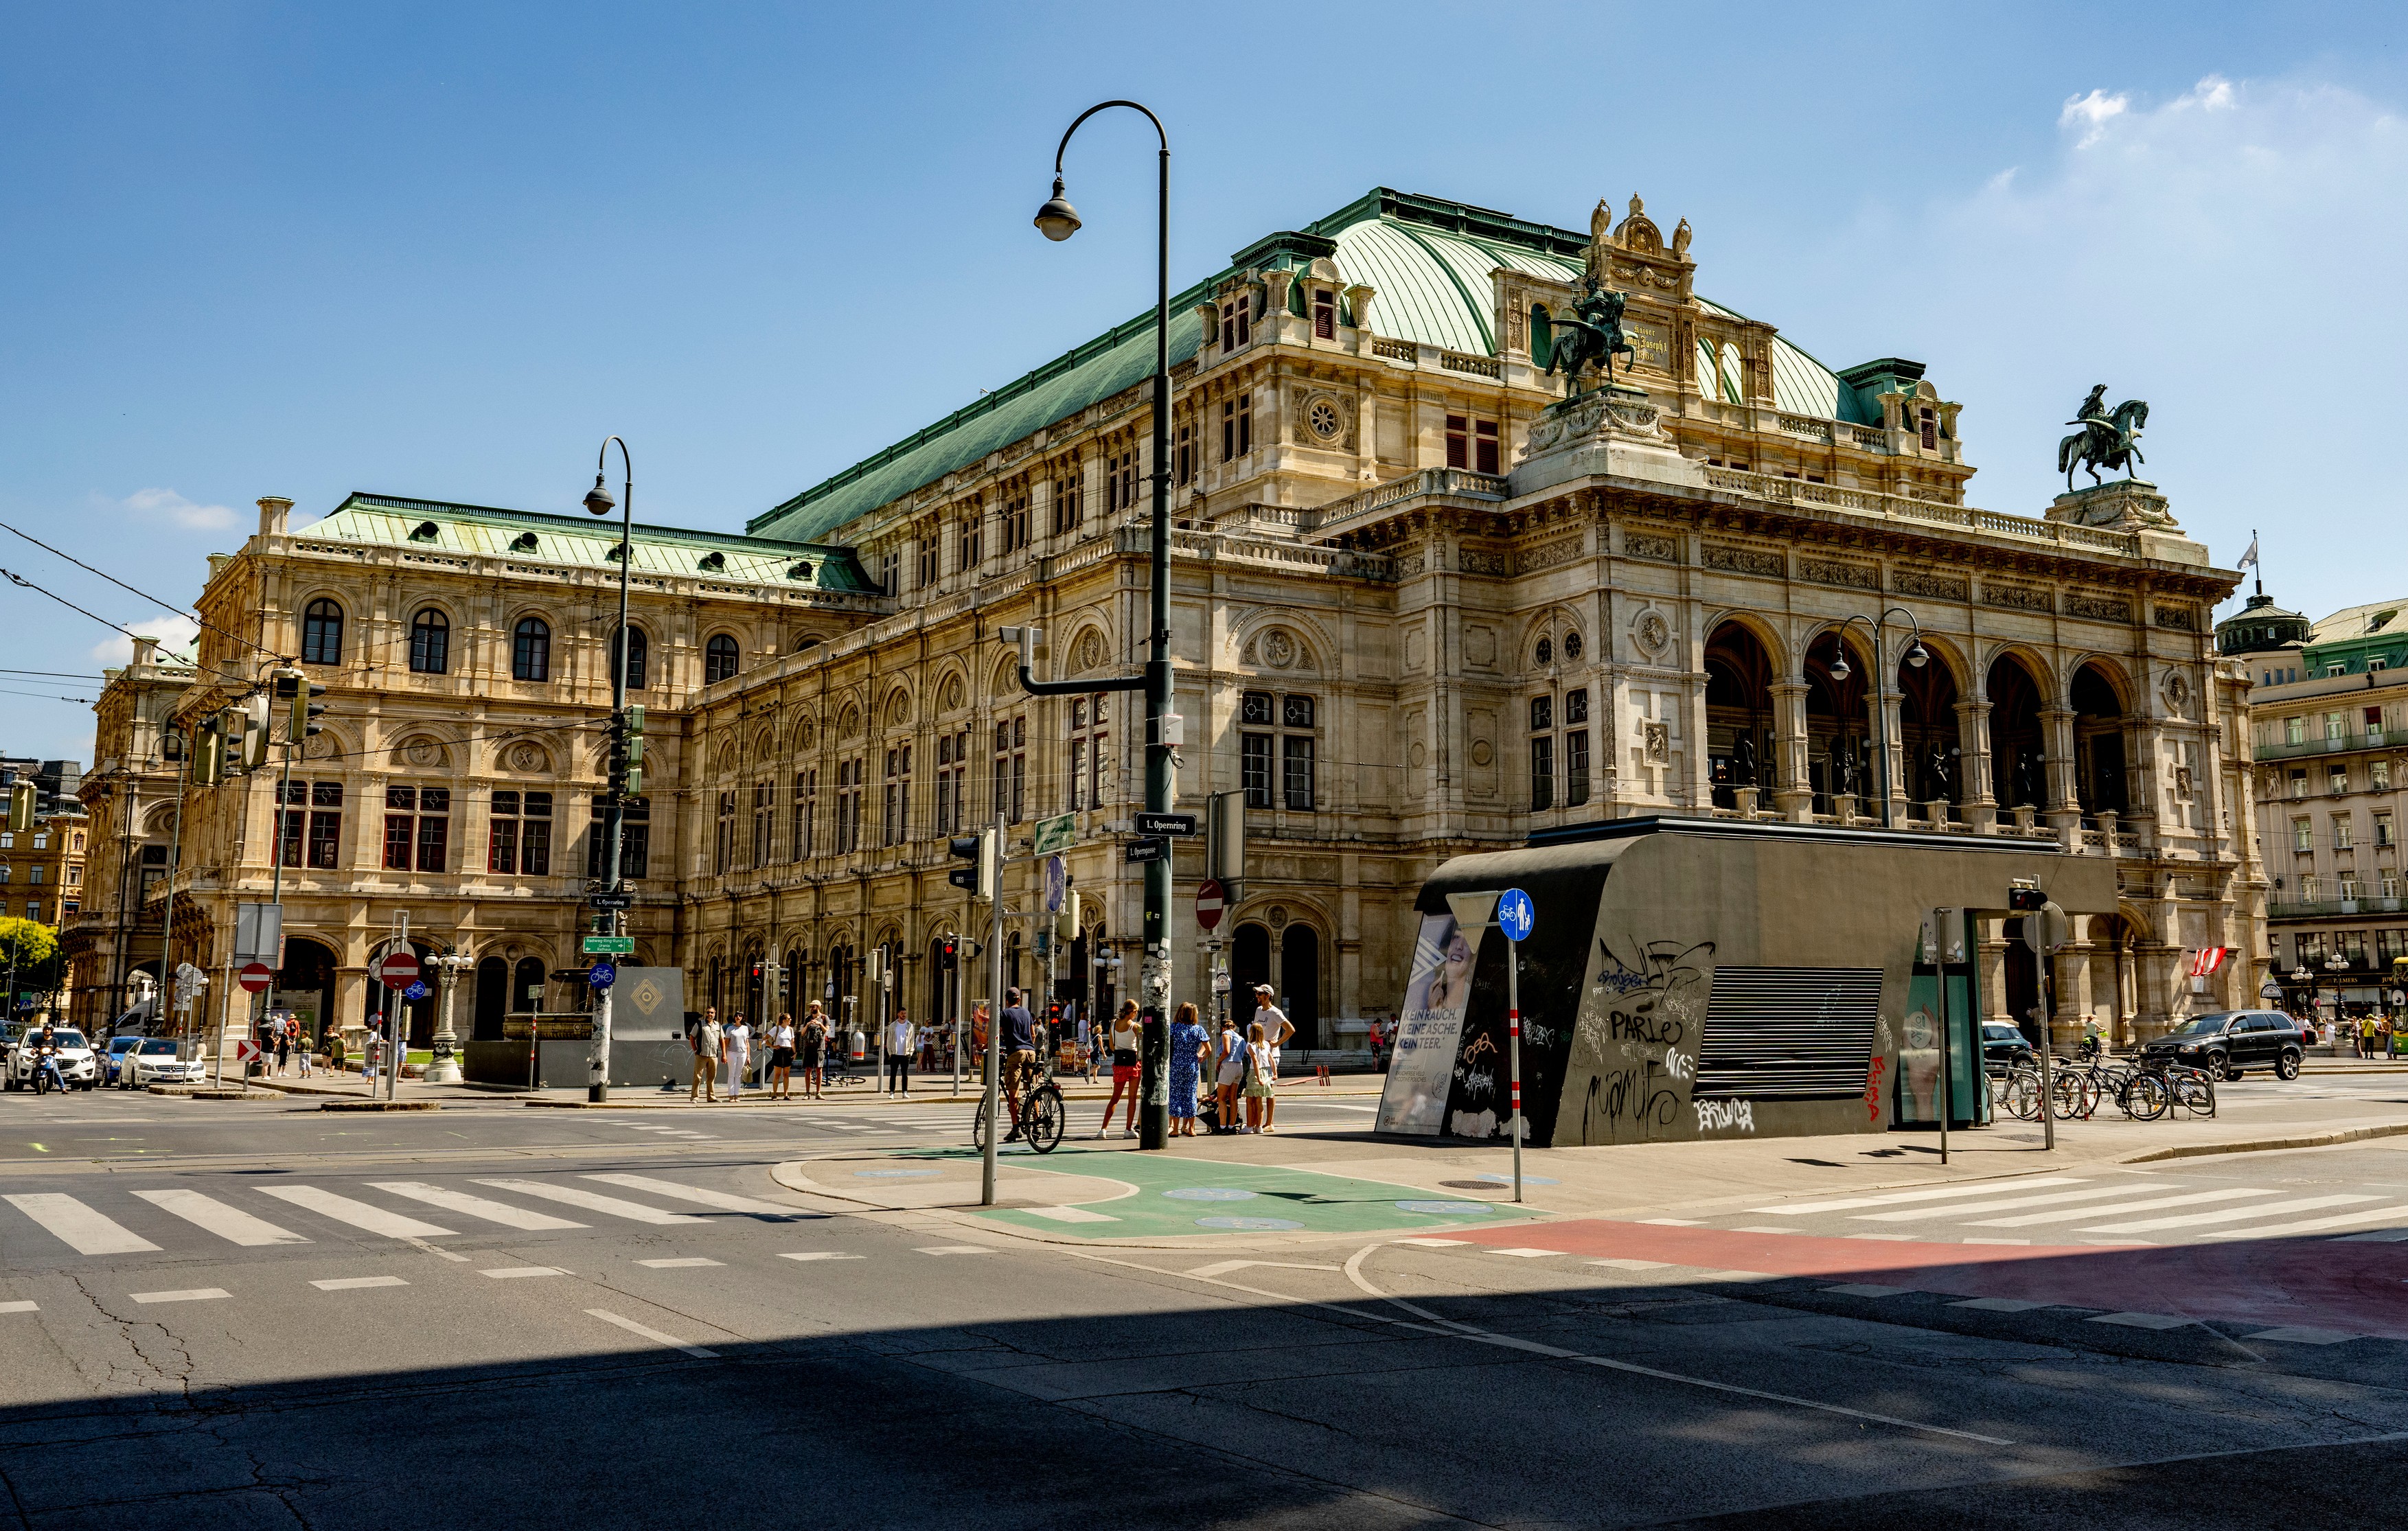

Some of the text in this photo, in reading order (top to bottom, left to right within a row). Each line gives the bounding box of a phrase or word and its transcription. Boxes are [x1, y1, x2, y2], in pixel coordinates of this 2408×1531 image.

[1634, 325, 1655, 336] Kaiser
[1625, 336, 1640, 350] ranz
[1640, 336, 1663, 354] Joseph
[1636, 350, 1654, 361] 1868
[1154, 820, 1186, 831] Opernring
[1134, 847, 1156, 857] Operngasse
[1403, 1008, 1457, 1021] KEIN RAUCH.
[1401, 1022, 1457, 1035] KEINE ASCHE.
[1397, 1037, 1418, 1049] KEIN
